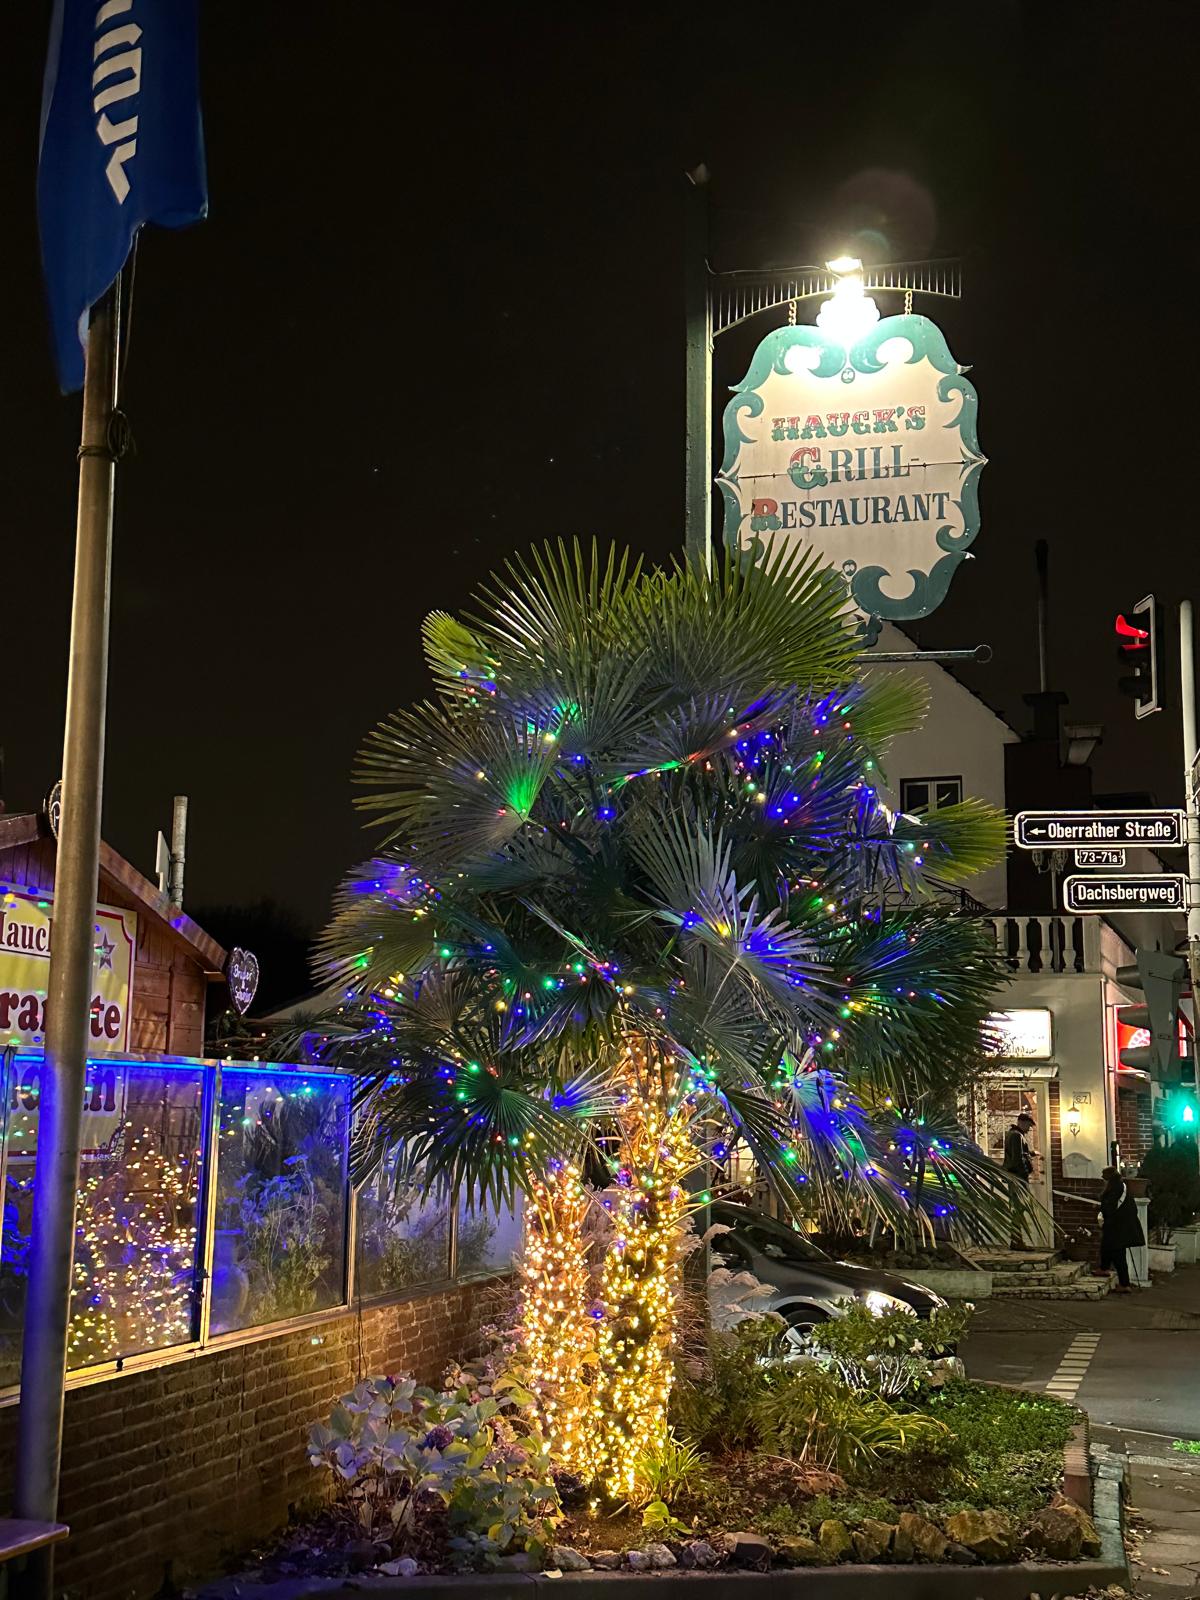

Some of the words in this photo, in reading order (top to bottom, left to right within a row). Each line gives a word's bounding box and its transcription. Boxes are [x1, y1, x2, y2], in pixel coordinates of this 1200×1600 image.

[771, 405, 926, 442] HAUCK'S
[750, 492, 950, 532] RESTAURANT
[1048, 822, 1120, 839] Oberrather
[1125, 821, 1171, 838] Straße
[1077, 884, 1175, 903] Dachsbergweg
